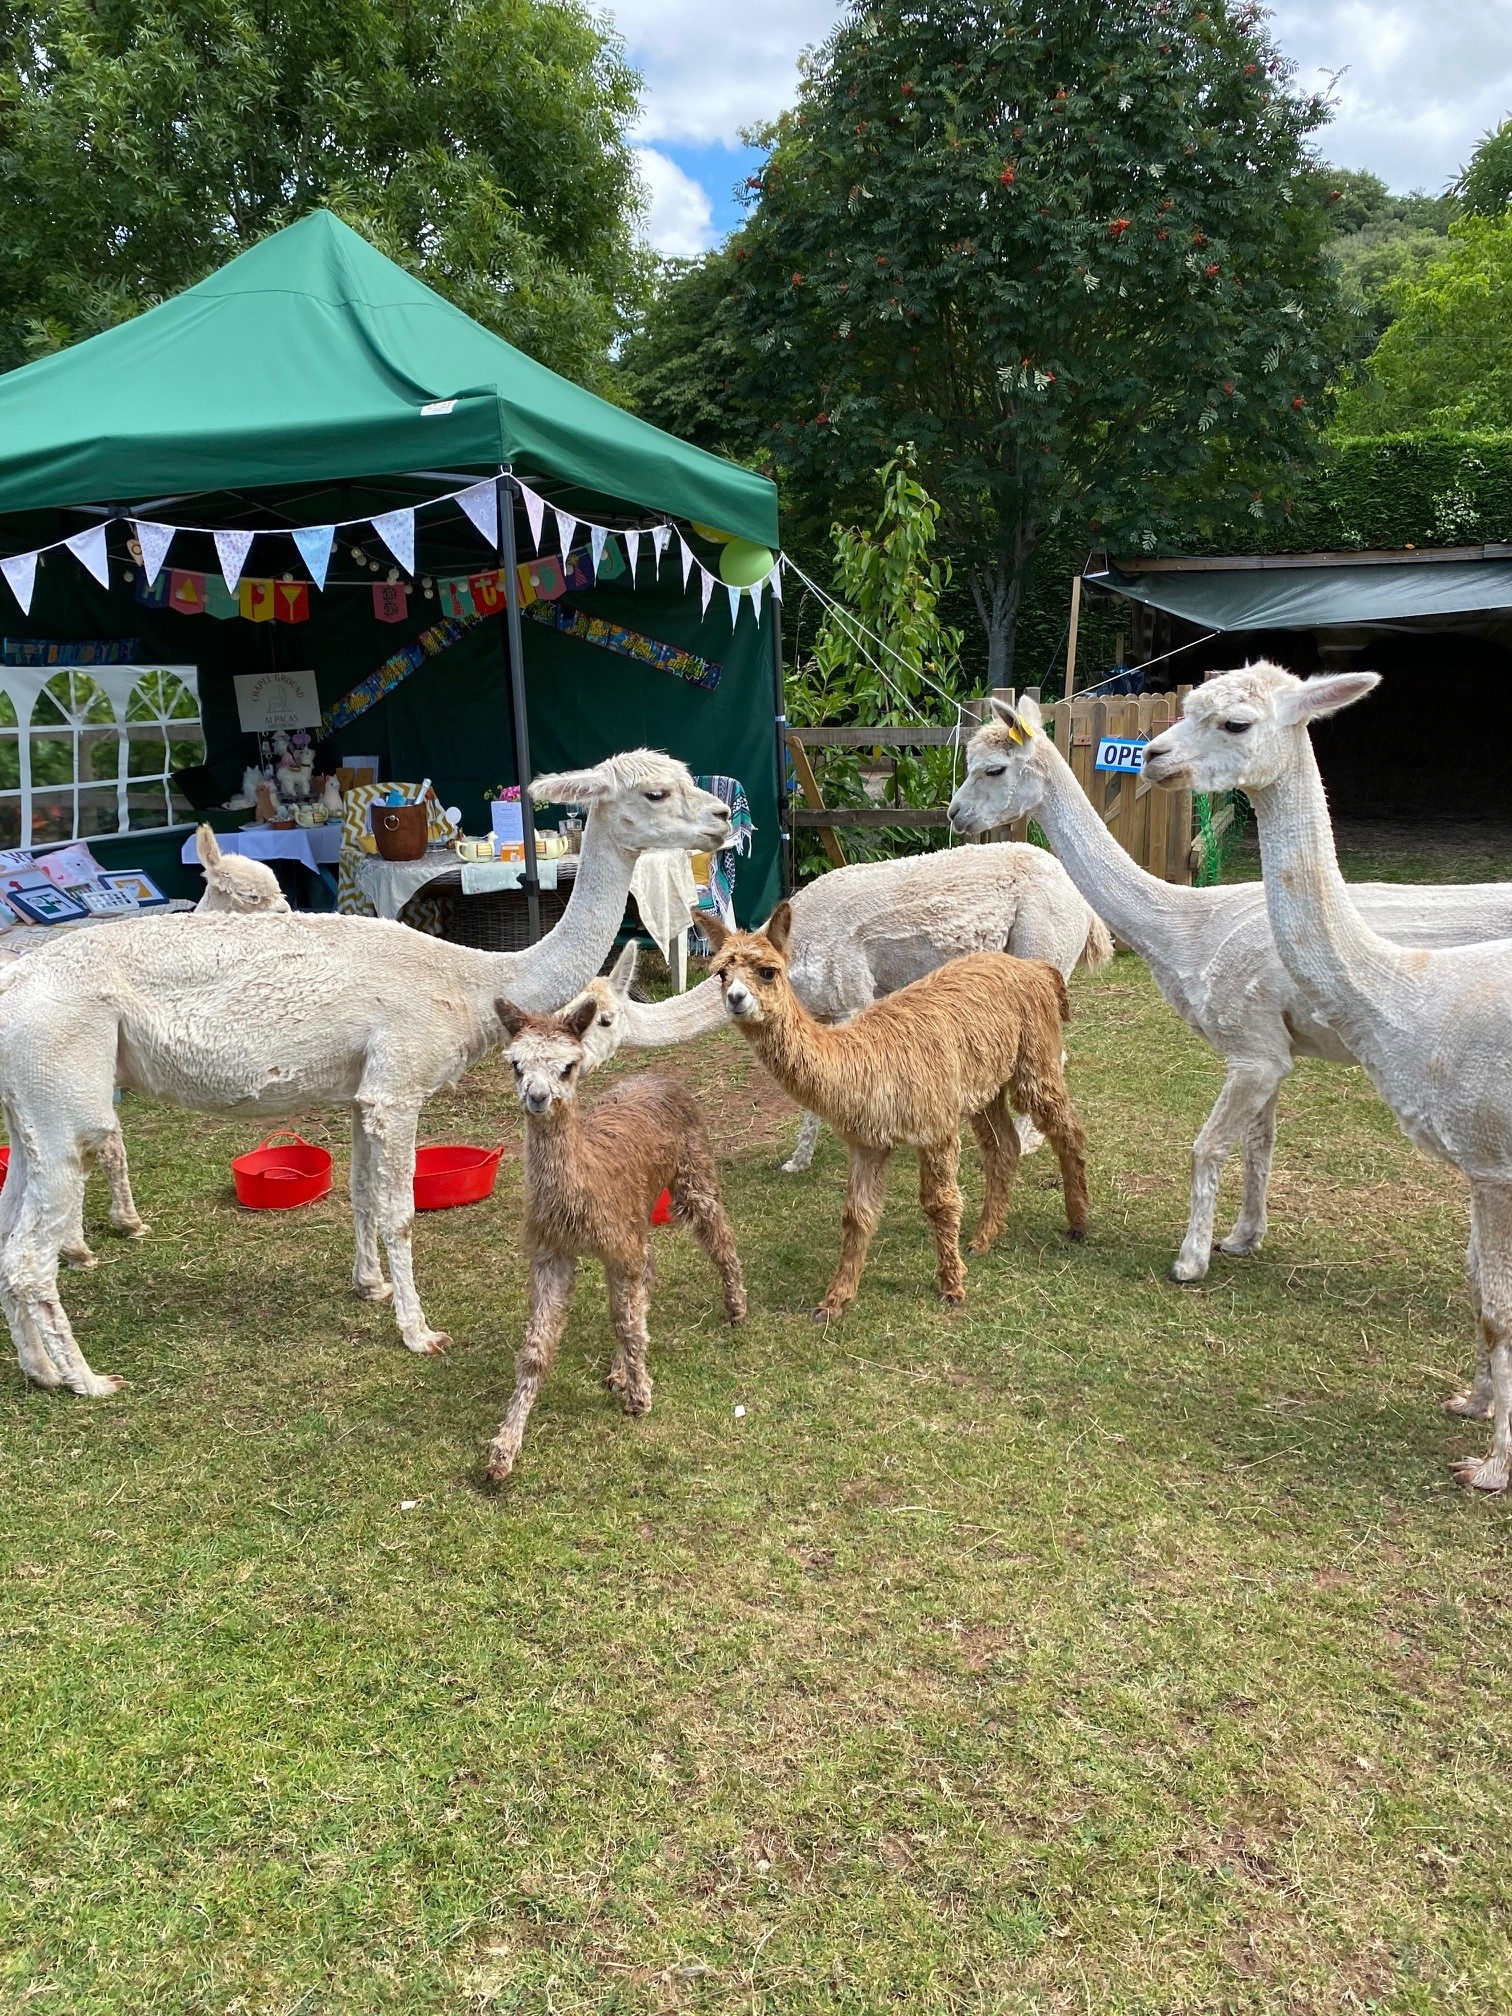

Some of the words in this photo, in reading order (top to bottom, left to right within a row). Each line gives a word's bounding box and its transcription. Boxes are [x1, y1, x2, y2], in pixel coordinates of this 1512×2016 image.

[141, 572, 303, 621] HAPY
[251, 675, 273, 702] CHAPEL
[274, 674, 305, 699] GROUND
[264, 715, 299, 724] ALPACAS
[1104, 745, 1144, 767] OPE
